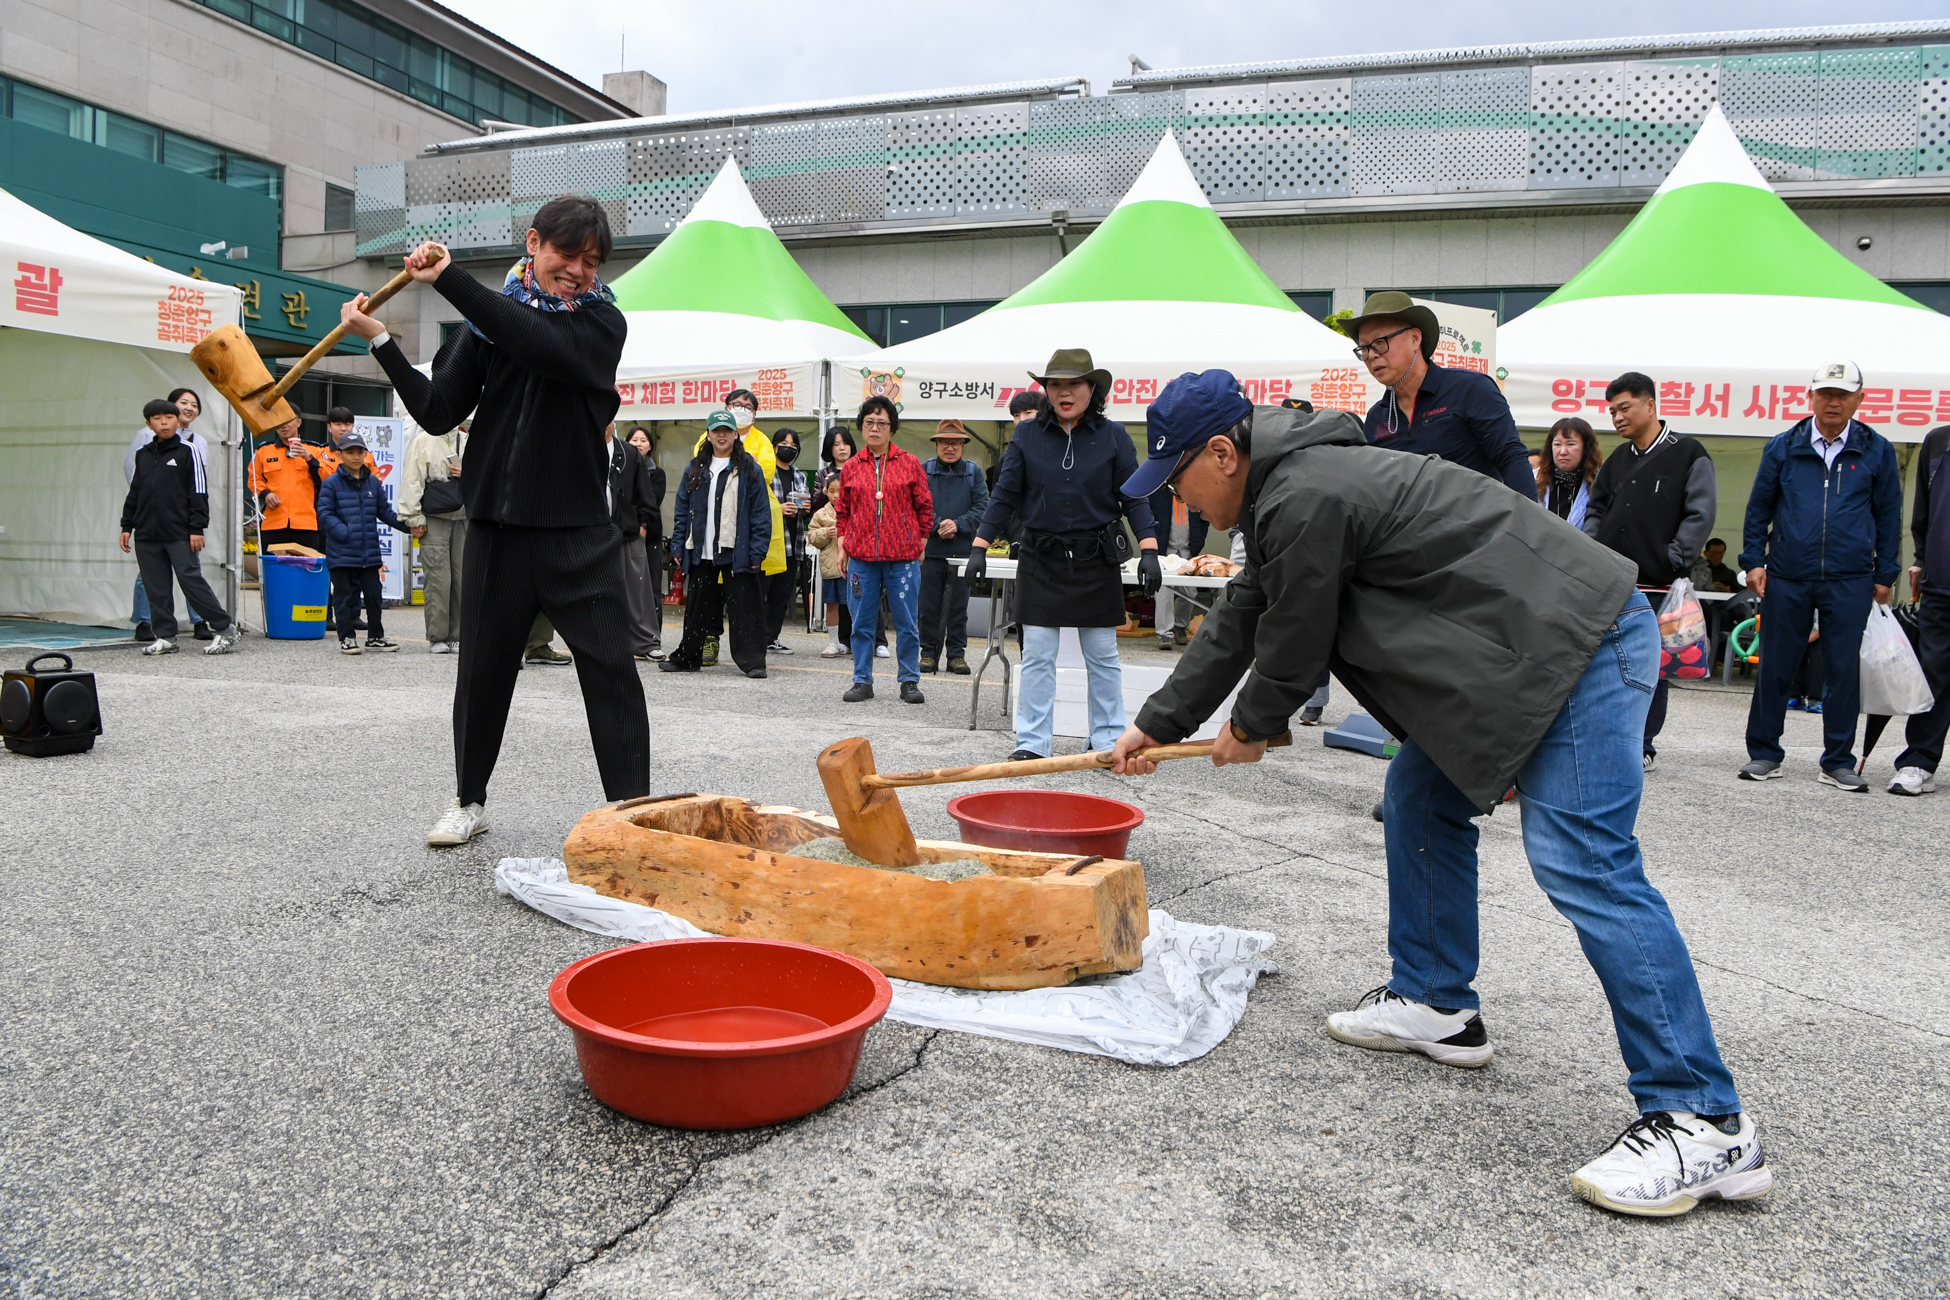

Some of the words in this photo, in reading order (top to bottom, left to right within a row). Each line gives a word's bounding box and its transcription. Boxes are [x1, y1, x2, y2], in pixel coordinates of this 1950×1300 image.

[14, 261, 63, 316] 괄
[168, 285, 205, 306] 2025
[157, 300, 212, 327] 청춘양구
[1437, 340, 1456, 352] 2025
[758, 368, 787, 381] 2025
[1320, 368, 1358, 382] 2025
[614, 383, 635, 406] 전
[641, 381, 676, 405] 체험
[682, 379, 737, 404] 한마당
[750, 381, 794, 396] 청춘양구
[919, 381, 995, 400] 양구소방서
[1105, 378, 1158, 404] 안전
[1248, 378, 1293, 405] 마당
[1310, 382, 1367, 399] 청춘양구
[1551, 378, 1731, 418] 양구찰서
